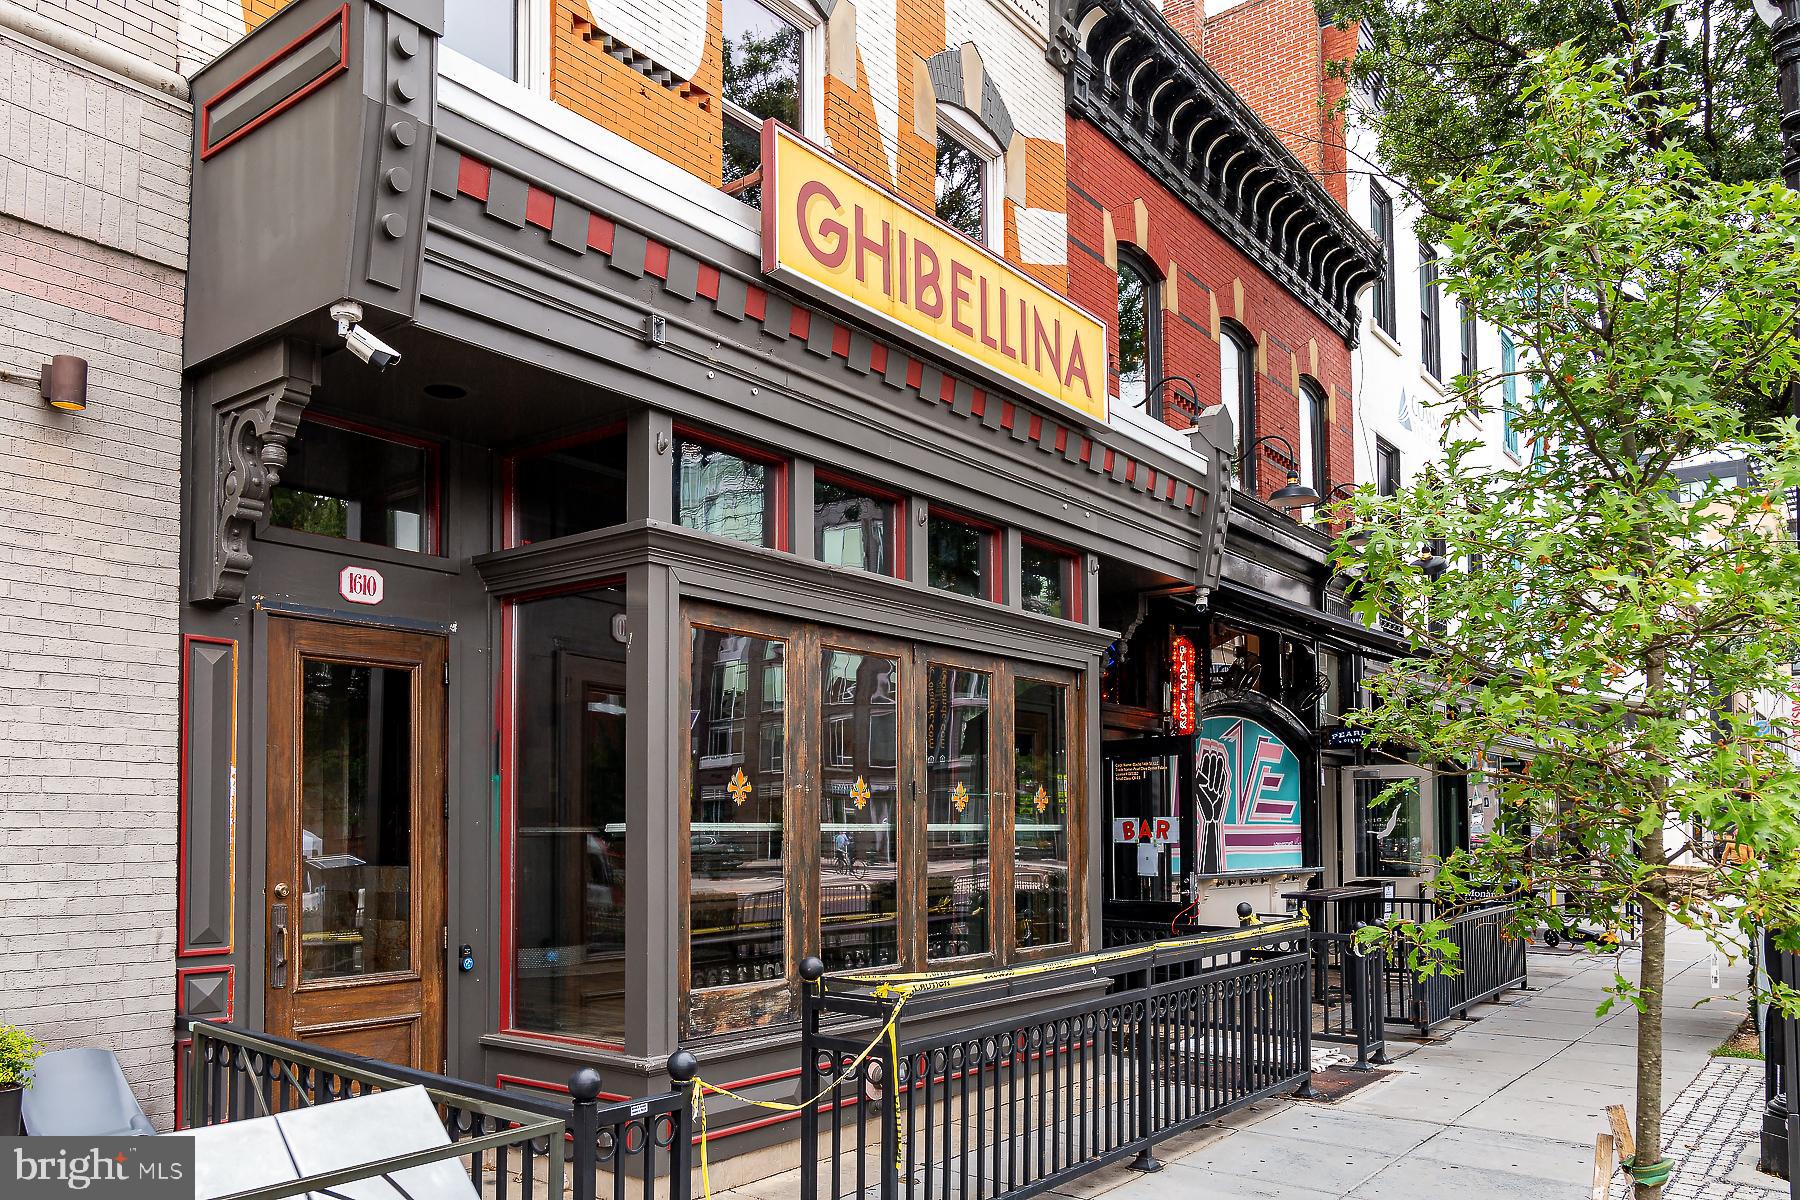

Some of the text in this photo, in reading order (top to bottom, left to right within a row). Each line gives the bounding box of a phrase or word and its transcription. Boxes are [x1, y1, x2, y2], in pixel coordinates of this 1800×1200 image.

[796, 181, 1092, 398] GHIBELLINA
[349, 572, 377, 597] 1610
[1331, 729, 1367, 741] PEARL
[1122, 818, 1170, 841] BAR
